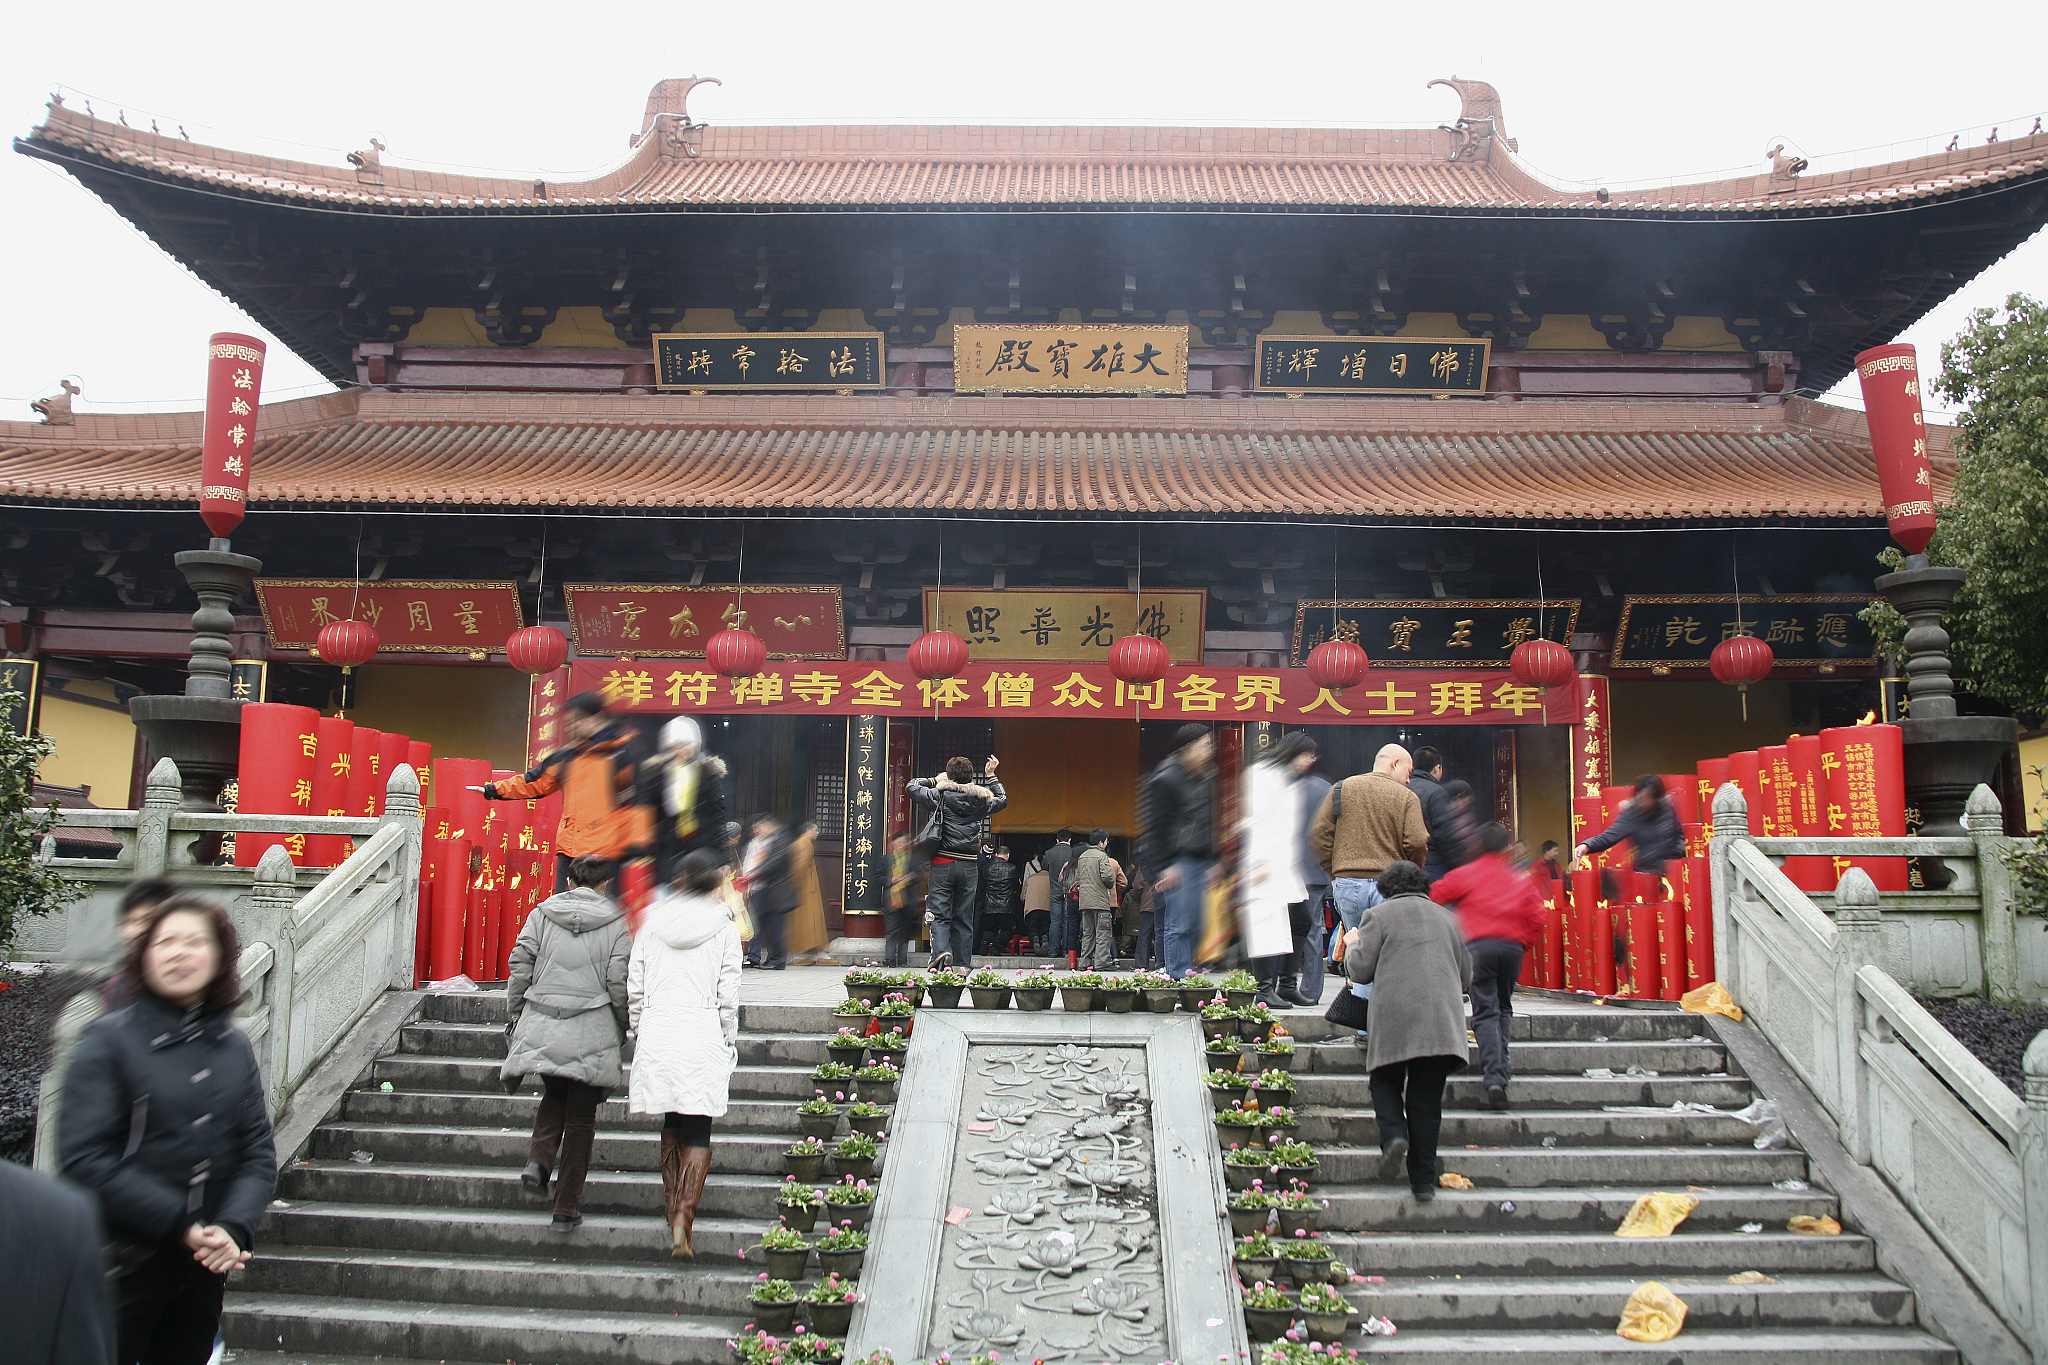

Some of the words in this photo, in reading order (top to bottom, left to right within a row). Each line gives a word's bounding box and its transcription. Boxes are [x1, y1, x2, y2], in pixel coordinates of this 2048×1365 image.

[687, 345, 857, 381] 法輪常轉
[985, 339, 1170, 378] 大雄寶殿
[1288, 346, 1460, 385] 佛日增輝
[222, 368, 254, 477] 法輪常轉
[600, 668, 1544, 717] 祥符禅寺全体僧众向各界人士拜年
